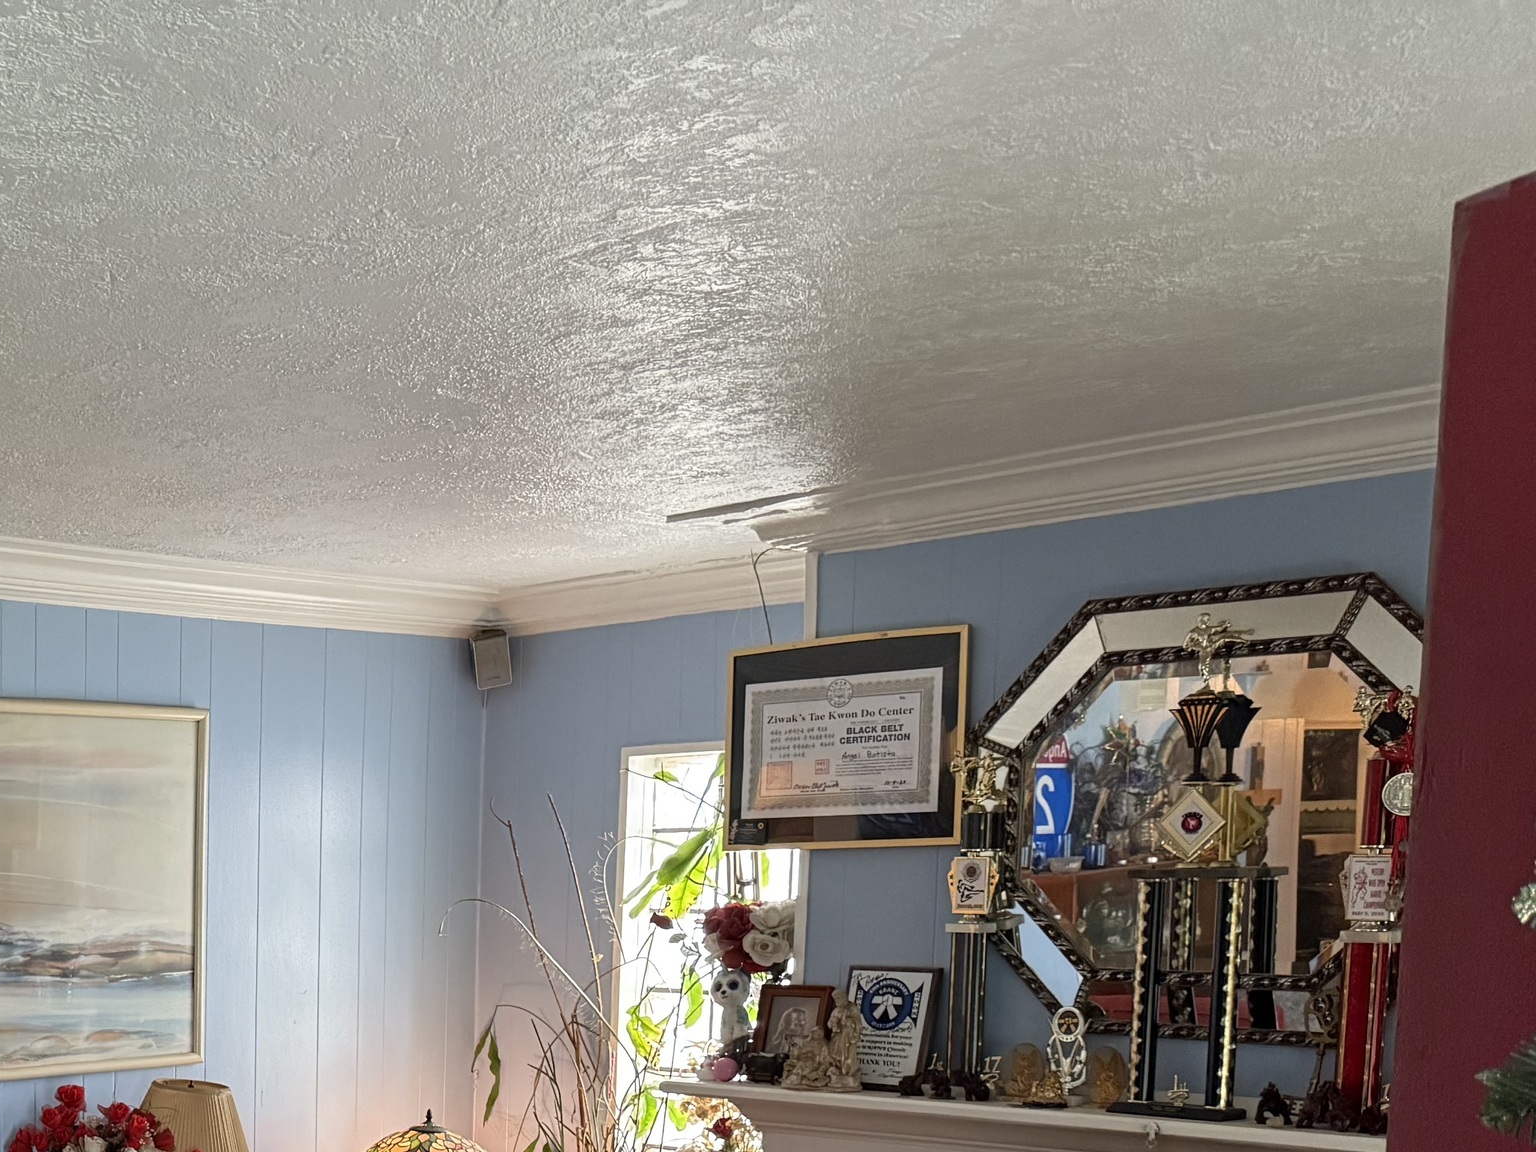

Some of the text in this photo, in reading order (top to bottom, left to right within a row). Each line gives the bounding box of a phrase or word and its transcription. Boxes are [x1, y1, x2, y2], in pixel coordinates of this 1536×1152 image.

[767, 707, 915, 725] Ziwak's Tae Kwon Do Center
[846, 723, 904, 735] BLACK BELT
[839, 733, 911, 745] CERTIFICATION
